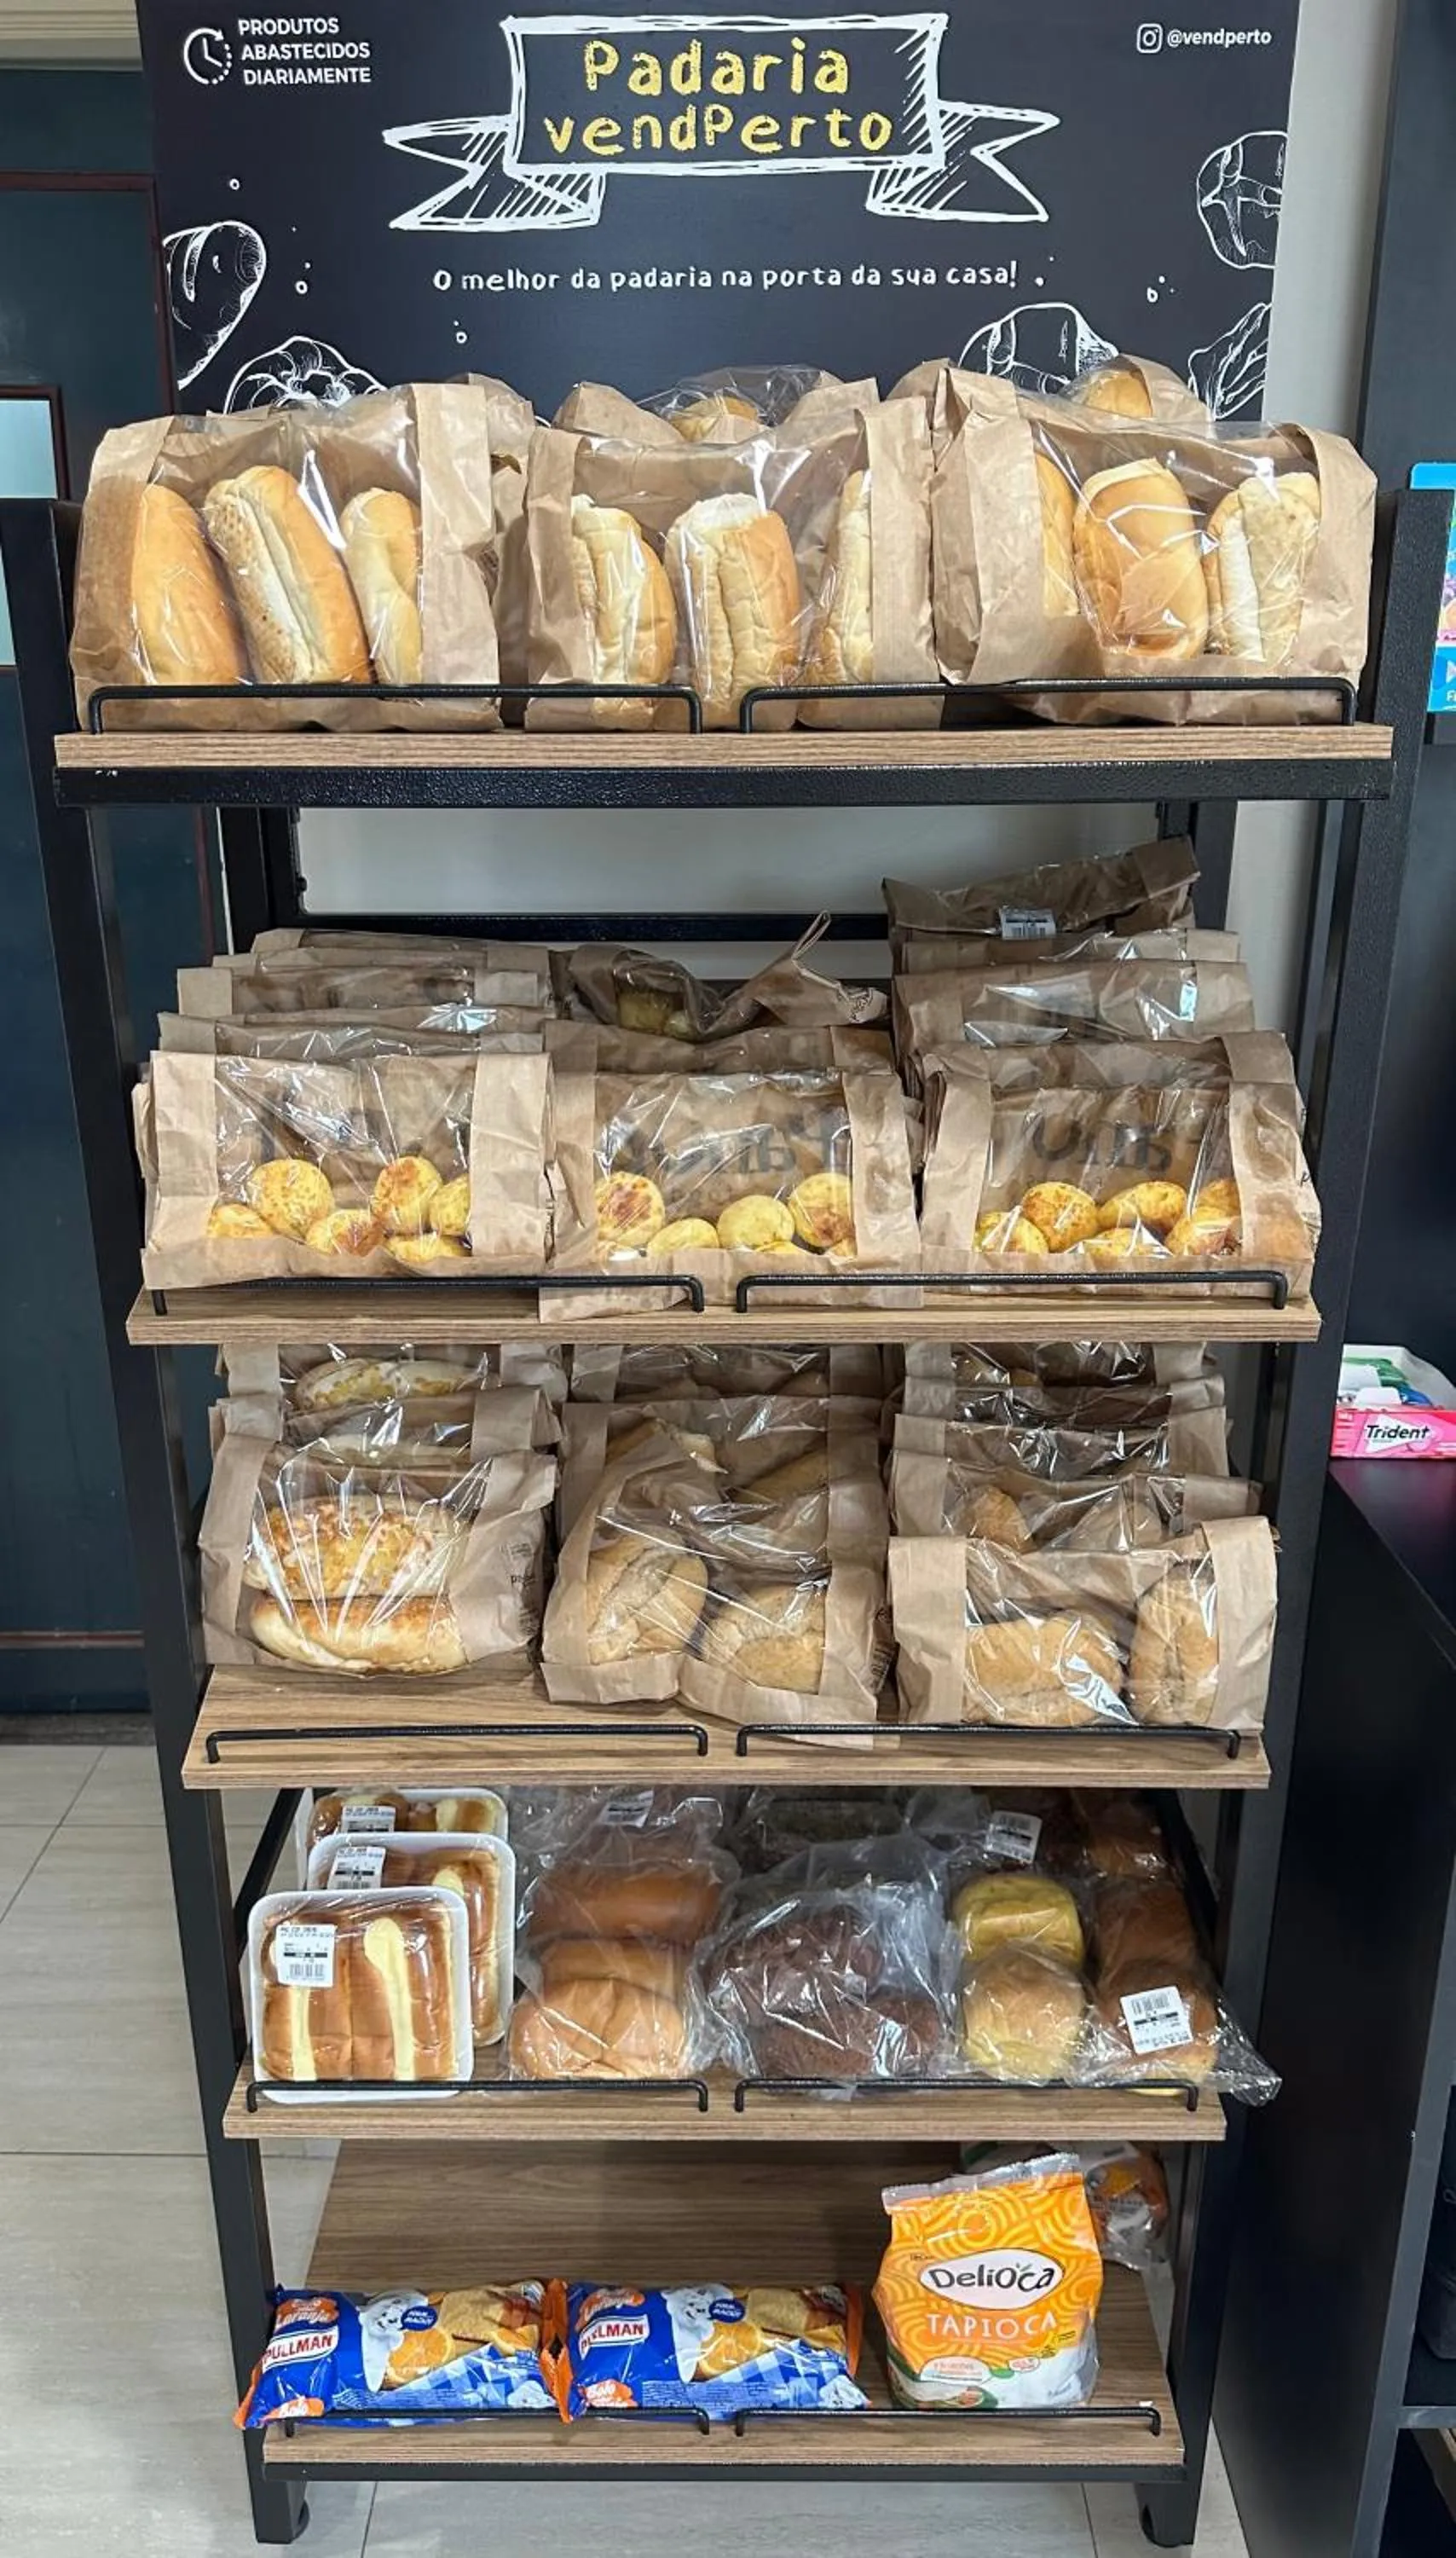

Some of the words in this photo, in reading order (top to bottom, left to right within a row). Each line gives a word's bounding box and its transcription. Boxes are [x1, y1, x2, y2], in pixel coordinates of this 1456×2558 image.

[238, 17, 340, 36] PRODUTOS
[1167, 27, 1272, 49] @vendperto
[241, 42, 371, 61] ABASTECIDOS
[243, 67, 372, 86] DIARIAMENTE
[584, 37, 849, 96] Padaria
[543, 103, 893, 155] vendPerto
[433, 269, 452, 291] O
[461, 269, 560, 292] melhor
[570, 267, 601, 289] da
[610, 266, 713, 292] padaria
[721, 269, 753, 286] na
[762, 267, 841, 291] porta
[852, 263, 881, 286] da
[891, 267, 937, 287] sua
[945, 260, 1017, 288] casa!
[1366, 1425, 1430, 1439] Trident
[926, 2310, 1058, 2340] TAPIOCA
[263, 2334, 332, 2365] PULLMAN
